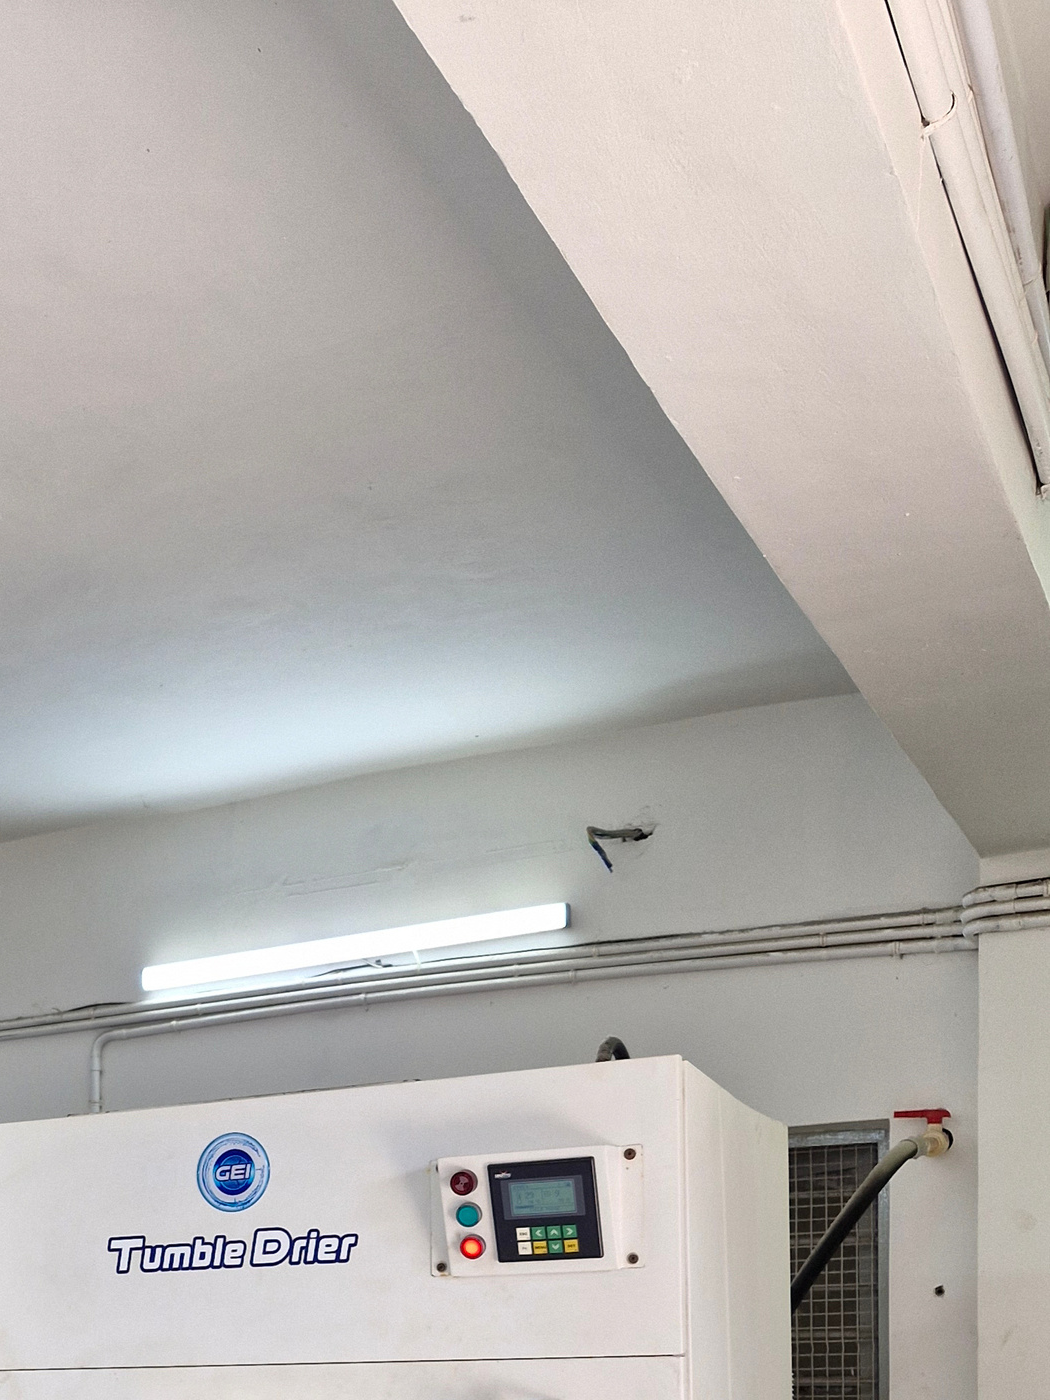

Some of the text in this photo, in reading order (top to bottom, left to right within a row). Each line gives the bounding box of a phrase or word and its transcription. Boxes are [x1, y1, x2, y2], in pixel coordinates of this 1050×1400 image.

[215, 1163, 251, 1182] GEI
[108, 1227, 358, 1274] Tumble Drier
